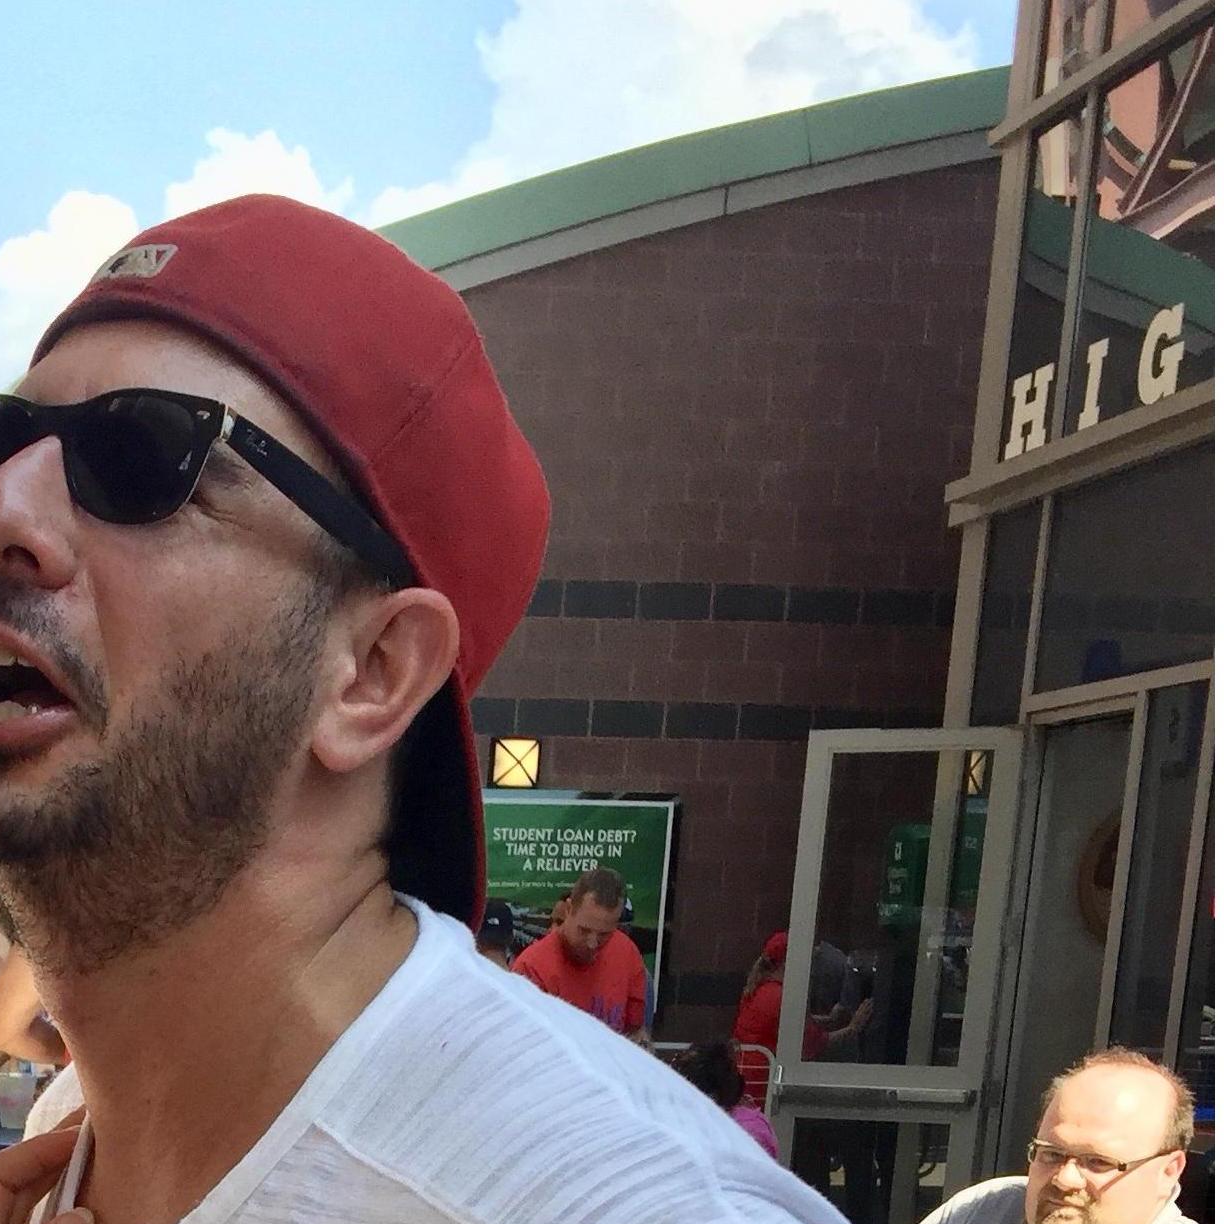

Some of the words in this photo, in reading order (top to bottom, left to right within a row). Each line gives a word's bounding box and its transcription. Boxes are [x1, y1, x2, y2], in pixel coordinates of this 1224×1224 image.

[1003, 302, 1186, 461] HIG
[493, 827, 554, 842] STUDENT
[556, 828, 594, 843] LOAN
[597, 829, 637, 844] DEBT?
[505, 843, 536, 857] TIME
[540, 843, 559, 857] TO
[562, 844, 604, 858] BRING
[608, 845, 622, 858] IN
[523, 858, 533, 872] A
